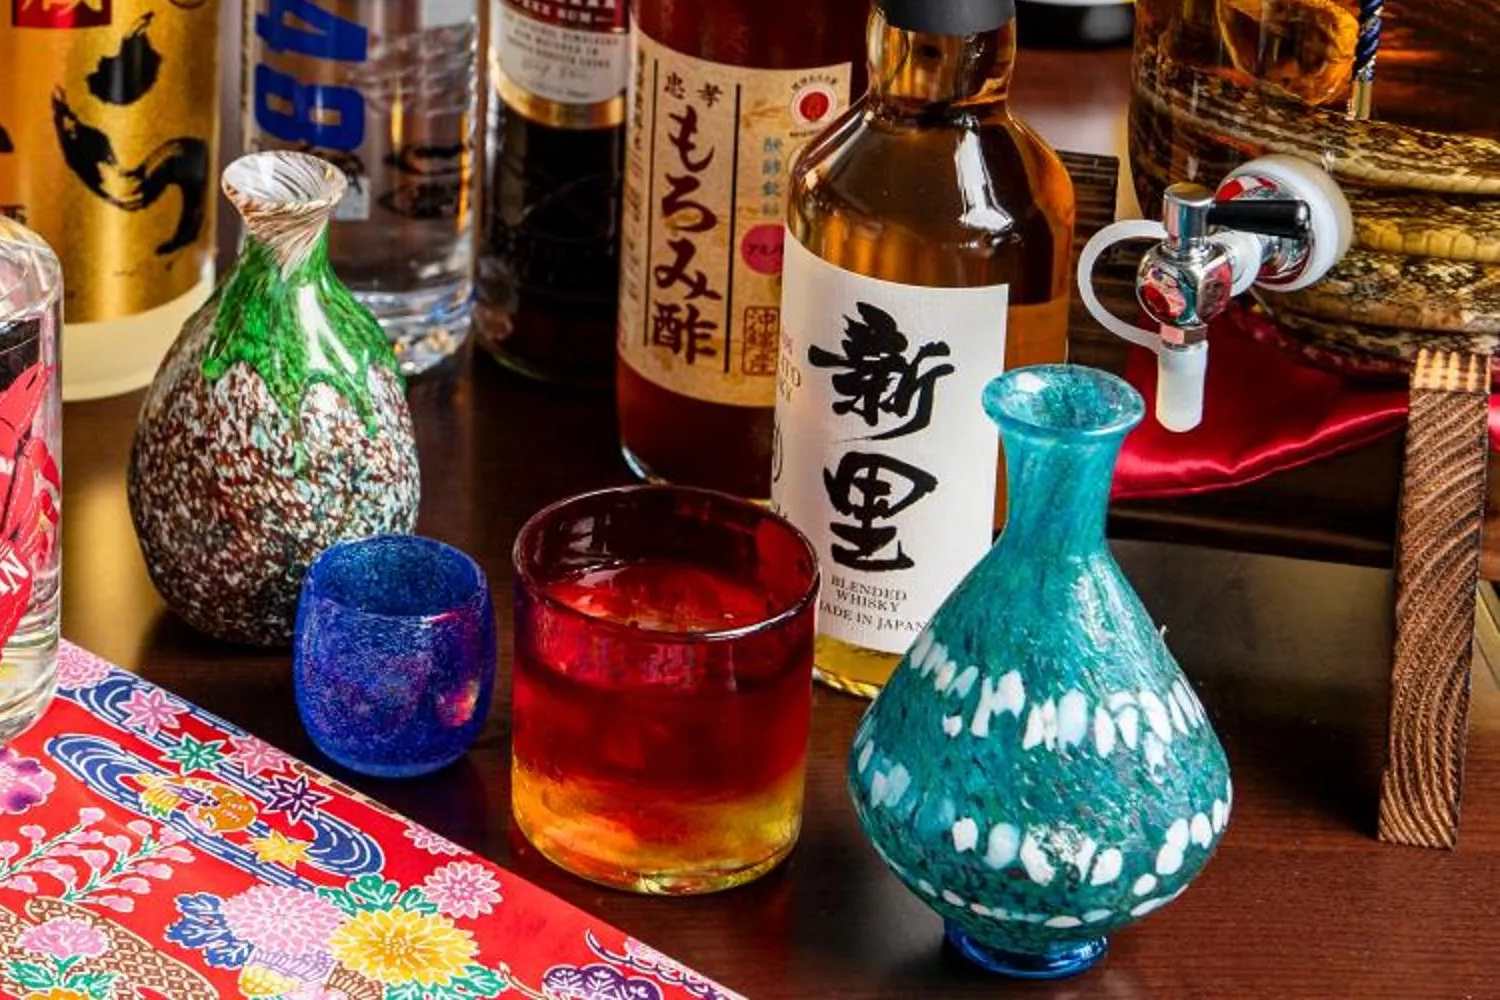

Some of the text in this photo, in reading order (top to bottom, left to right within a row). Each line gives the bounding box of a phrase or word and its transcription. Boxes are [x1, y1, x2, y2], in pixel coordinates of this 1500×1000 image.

[663, 71, 725, 108] 忠孝
[652, 106, 722, 366] もろみ酢
[808, 301, 955, 572] 新里
[830, 573, 908, 602] BLENDED
[835, 587, 901, 614] WHISKY
[857, 611, 875, 626] IN
